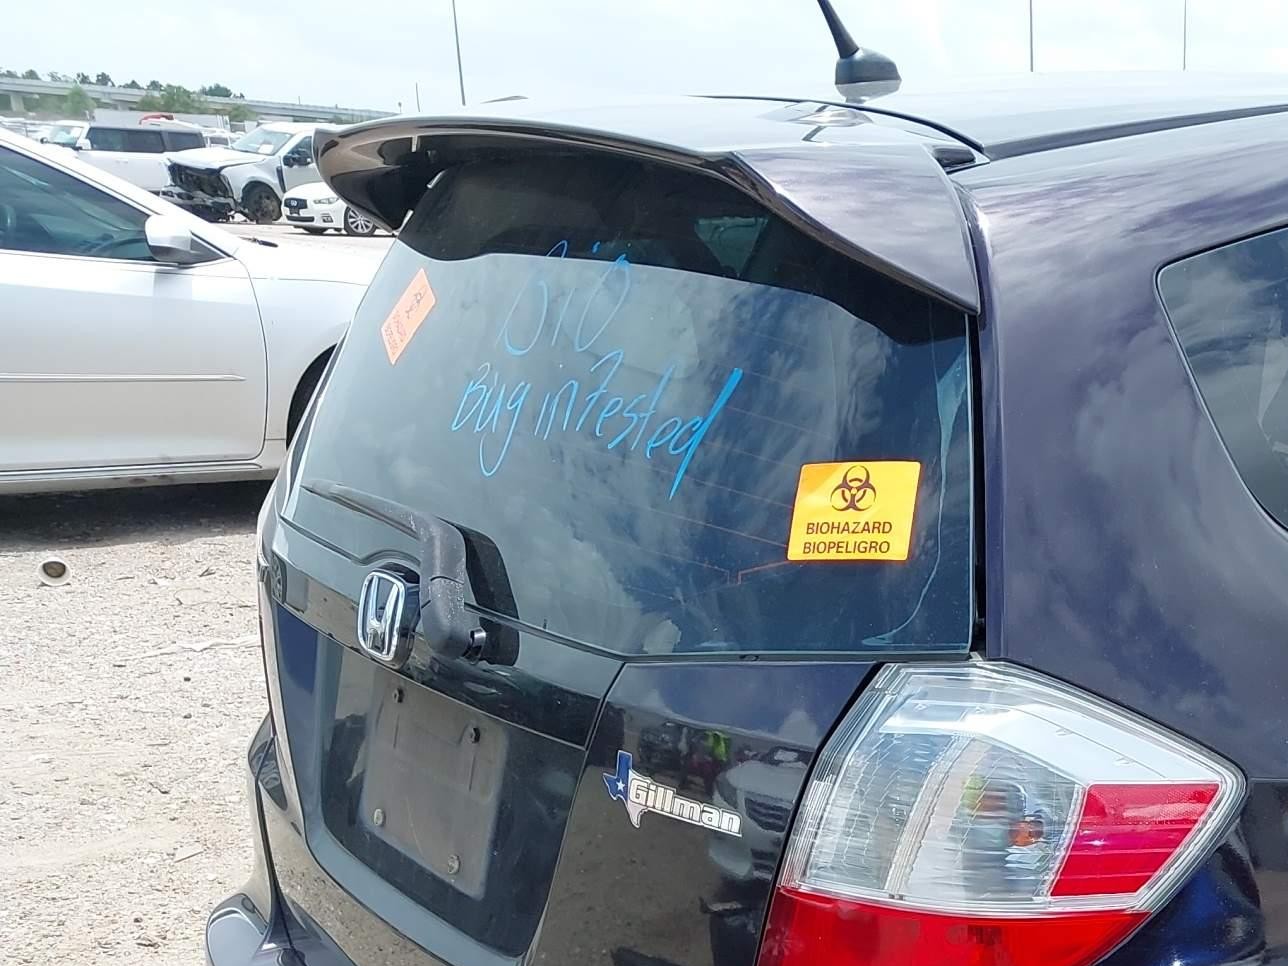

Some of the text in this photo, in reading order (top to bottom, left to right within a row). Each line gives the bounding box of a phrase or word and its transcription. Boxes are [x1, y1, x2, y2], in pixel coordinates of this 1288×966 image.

[451, 362, 533, 476] Bug
[806, 521, 893, 535] BIOHAZARD
[802, 540, 891, 555] BIOPELIGRO
[629, 777, 742, 834] Gillman
